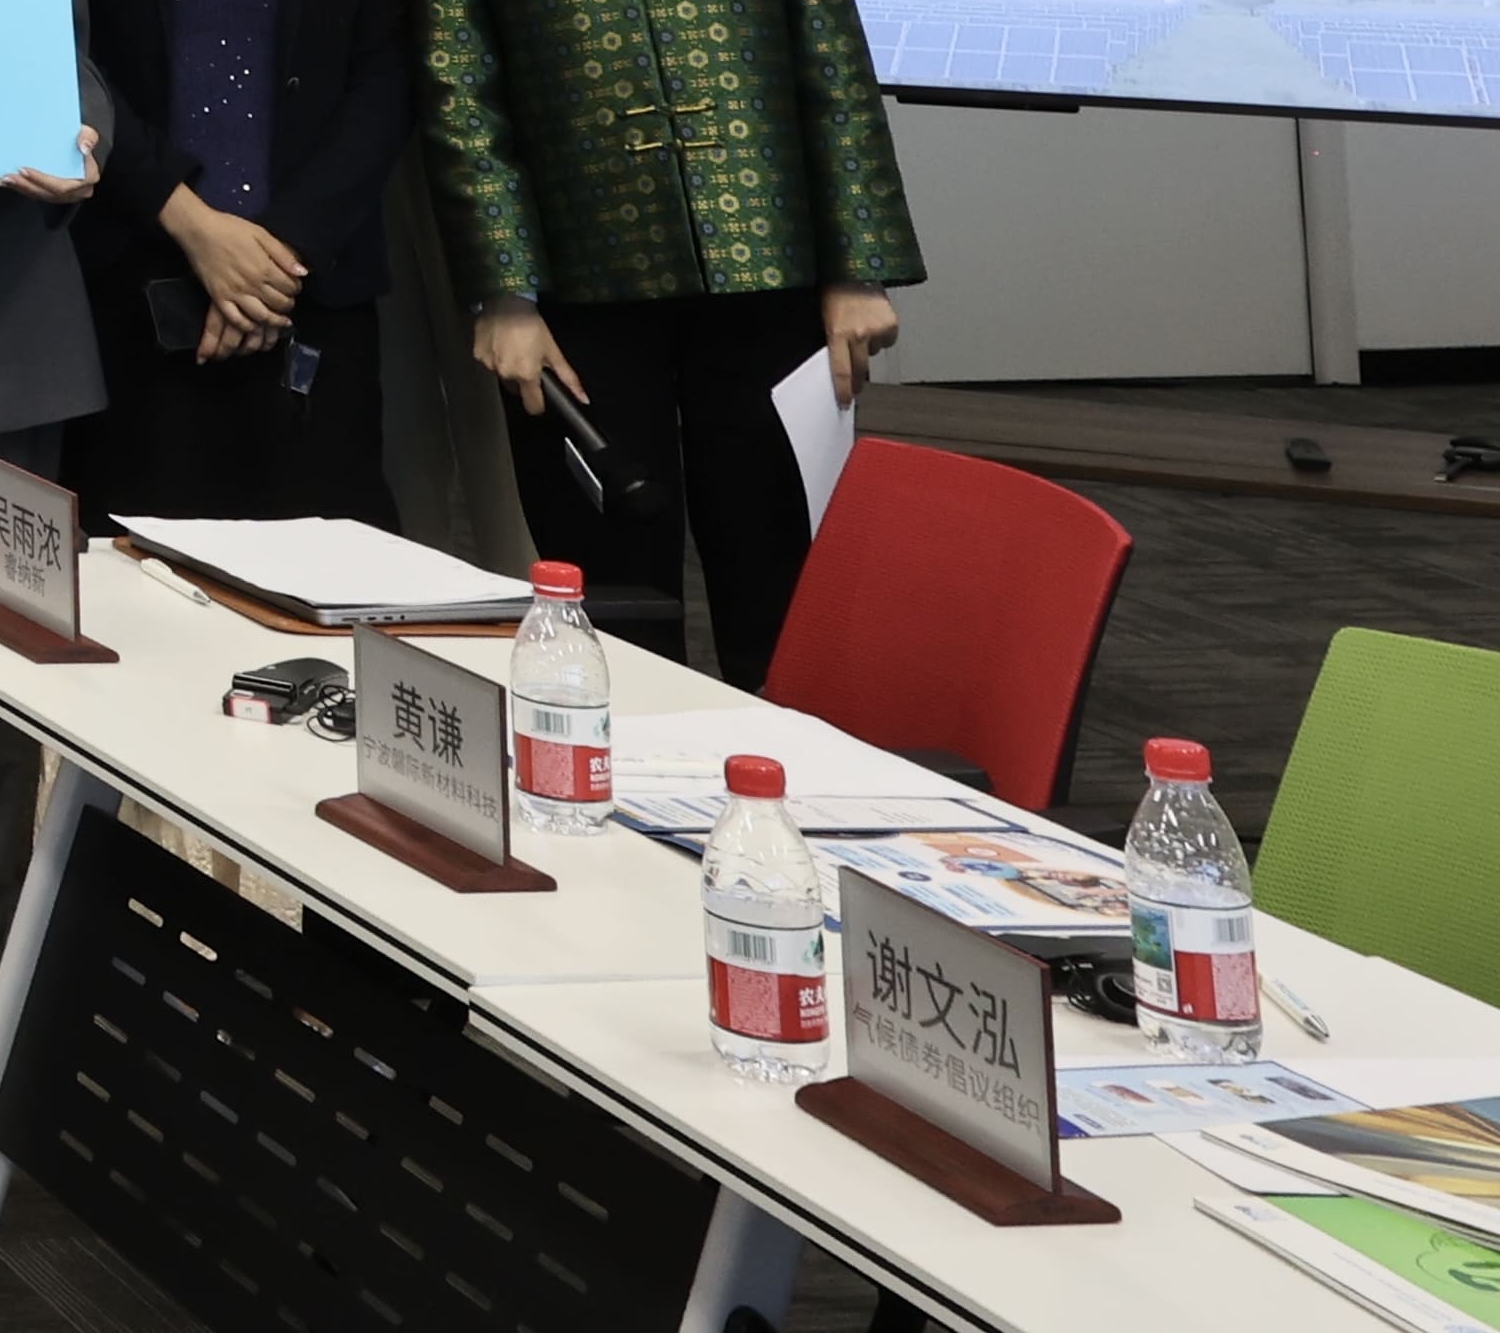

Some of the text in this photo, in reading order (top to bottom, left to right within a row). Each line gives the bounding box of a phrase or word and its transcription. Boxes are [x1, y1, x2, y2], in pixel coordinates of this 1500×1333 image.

[391, 681, 464, 769] 黄谦
[866, 930, 1021, 1079] 谢文泓
